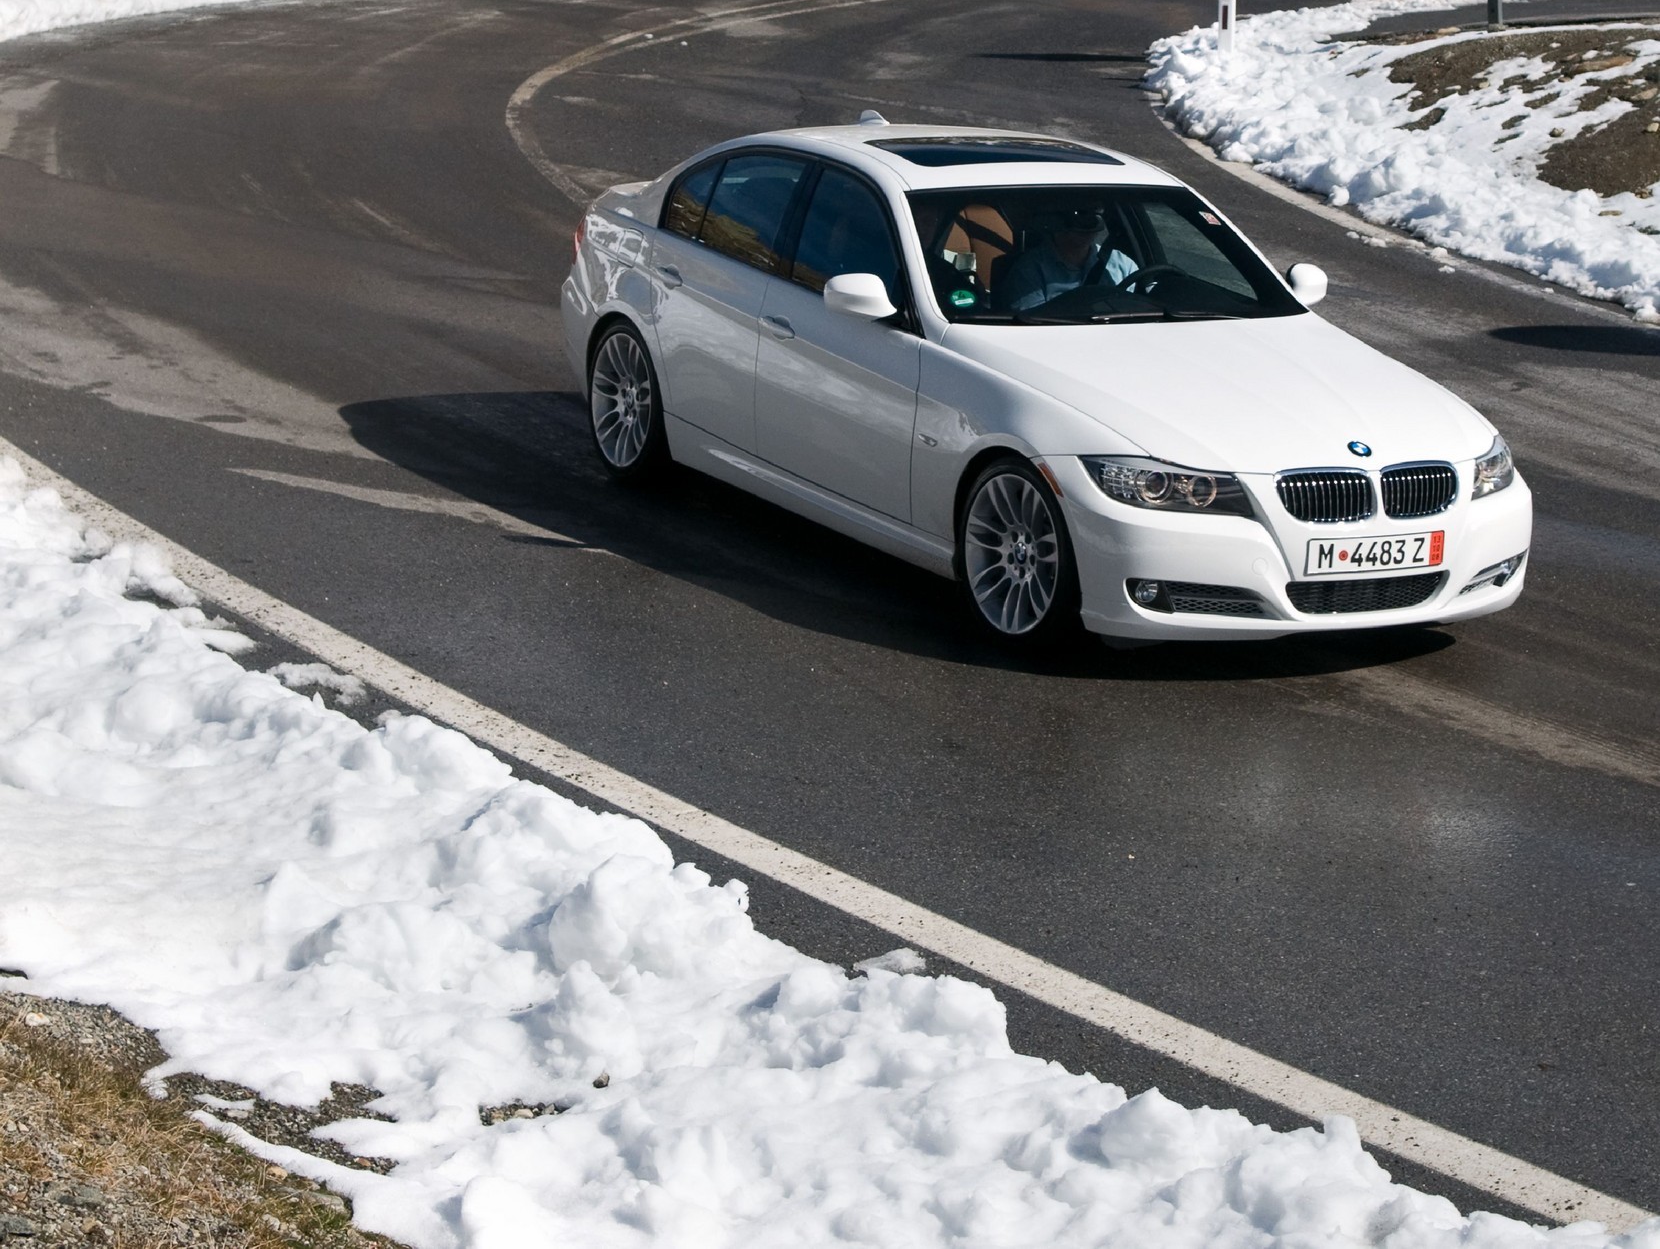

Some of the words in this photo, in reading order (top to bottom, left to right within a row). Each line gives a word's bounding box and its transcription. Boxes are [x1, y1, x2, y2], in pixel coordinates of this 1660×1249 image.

[1318, 543, 1334, 569] M
[1350, 540, 1406, 567] 4483
[1412, 537, 1425, 563] Z
